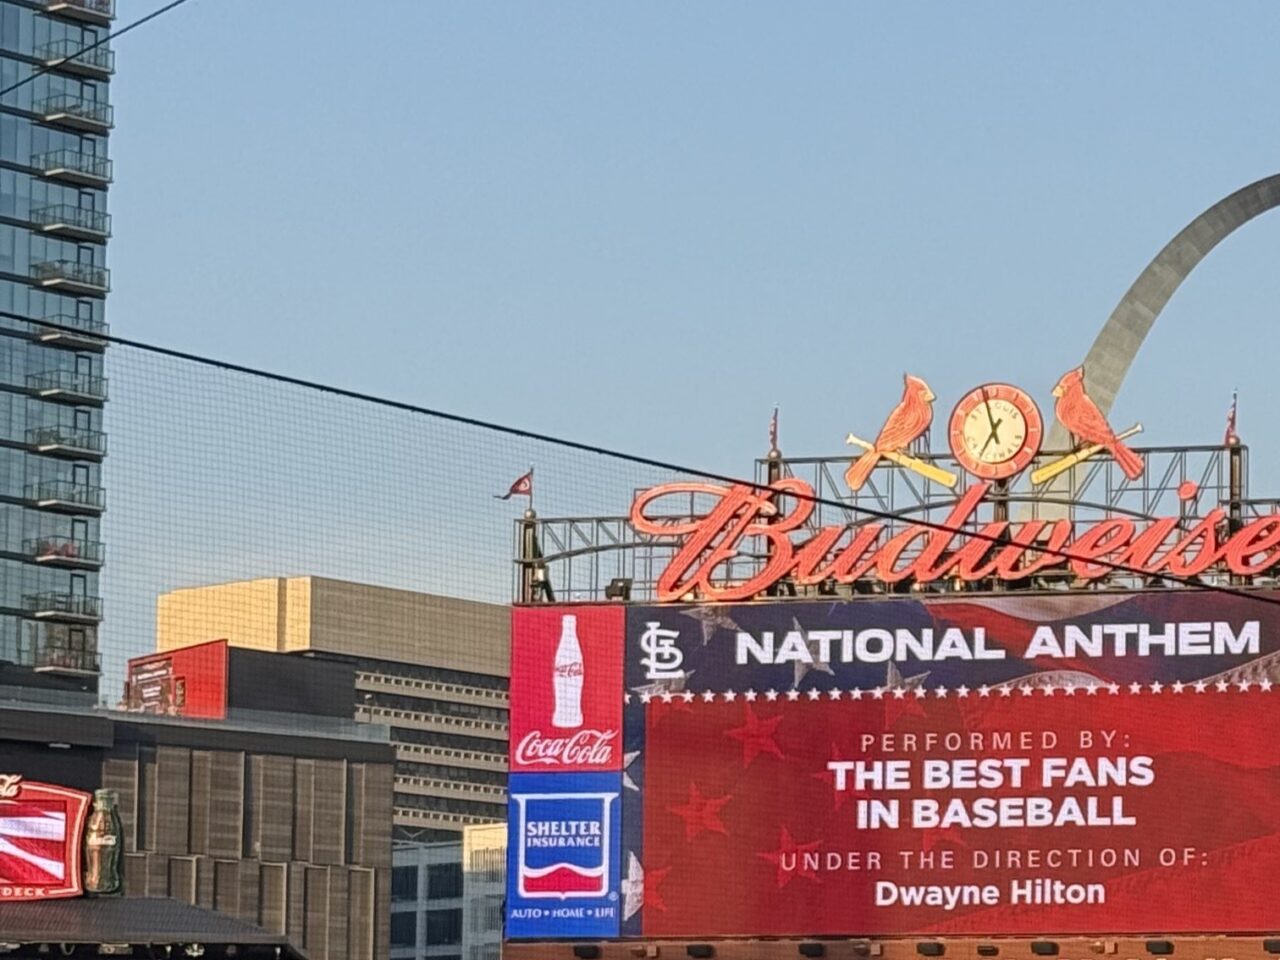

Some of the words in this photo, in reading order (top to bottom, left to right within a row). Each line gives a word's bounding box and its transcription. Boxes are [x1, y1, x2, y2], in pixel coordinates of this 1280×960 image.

[735, 626, 1005, 665] NATIONAL
[1024, 620, 1260, 660] ANTHEM
[861, 731, 1058, 752] PERFORMED
[1080, 730, 1131, 749] BY:
[827, 760, 911, 791] THE
[923, 758, 1030, 789] BEST
[1041, 756, 1155, 787] FANS
[856, 799, 900, 830] IN
[912, 796, 1136, 829] BASEBALL
[527, 821, 601, 836] SHELTER
[527, 836, 600, 848] INSURANCE
[781, 851, 882, 871] UNDER
[900, 850, 955, 869] THE
[973, 848, 1140, 869] DIRECTION
[1159, 847, 1208, 867] OF:
[3, 888, 46, 896] DECK
[875, 880, 1000, 909] Dwayne
[1010, 878, 1106, 905] Hilton
[511, 909, 542, 918] AUTO
